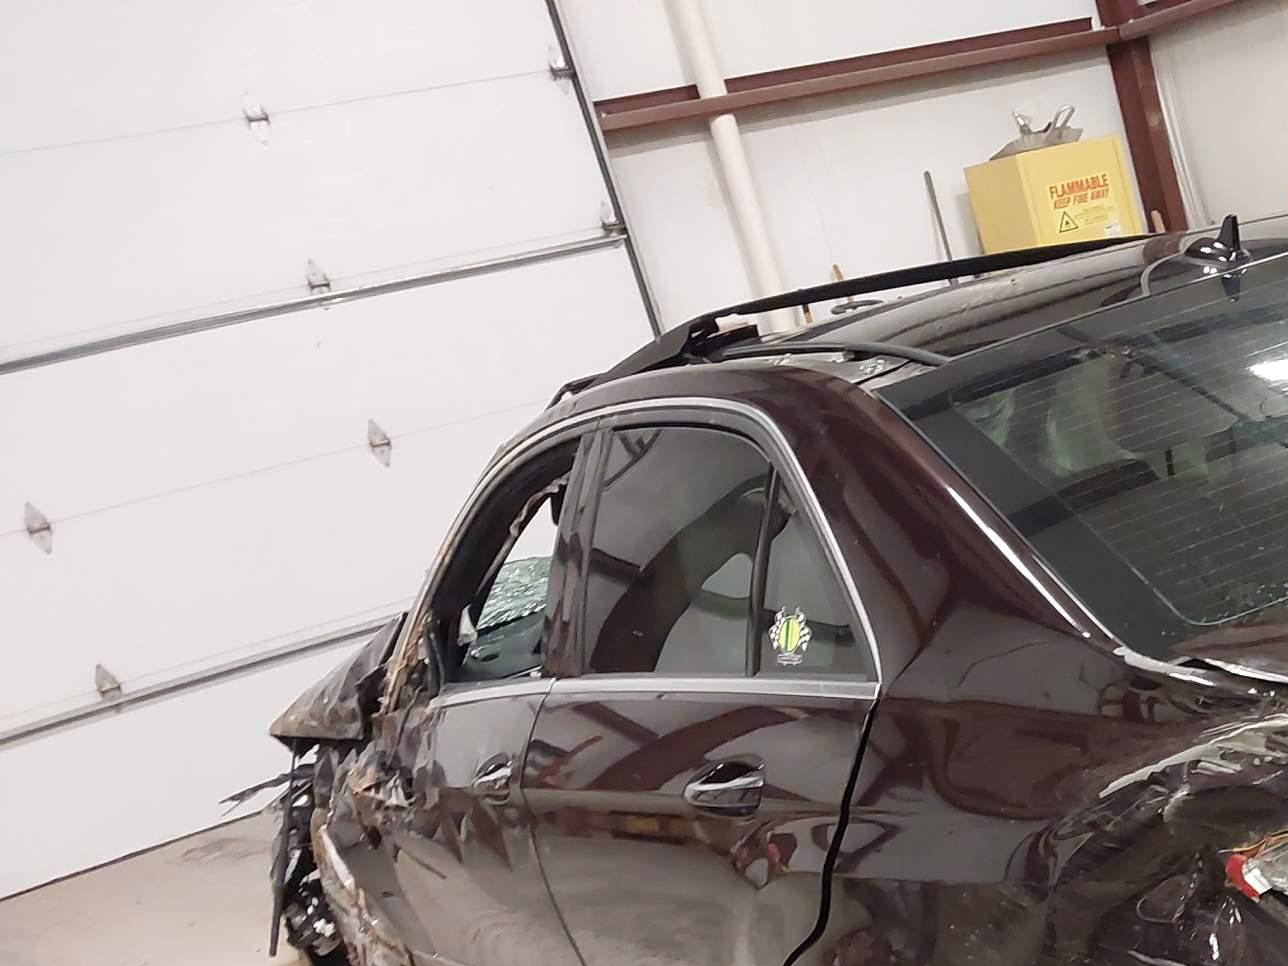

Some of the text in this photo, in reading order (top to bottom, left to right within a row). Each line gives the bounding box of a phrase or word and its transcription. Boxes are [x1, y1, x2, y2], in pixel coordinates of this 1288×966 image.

[1049, 173, 1109, 200] FLAMMABLE
[1053, 187, 1109, 209] KEEP FIRE AWAY
